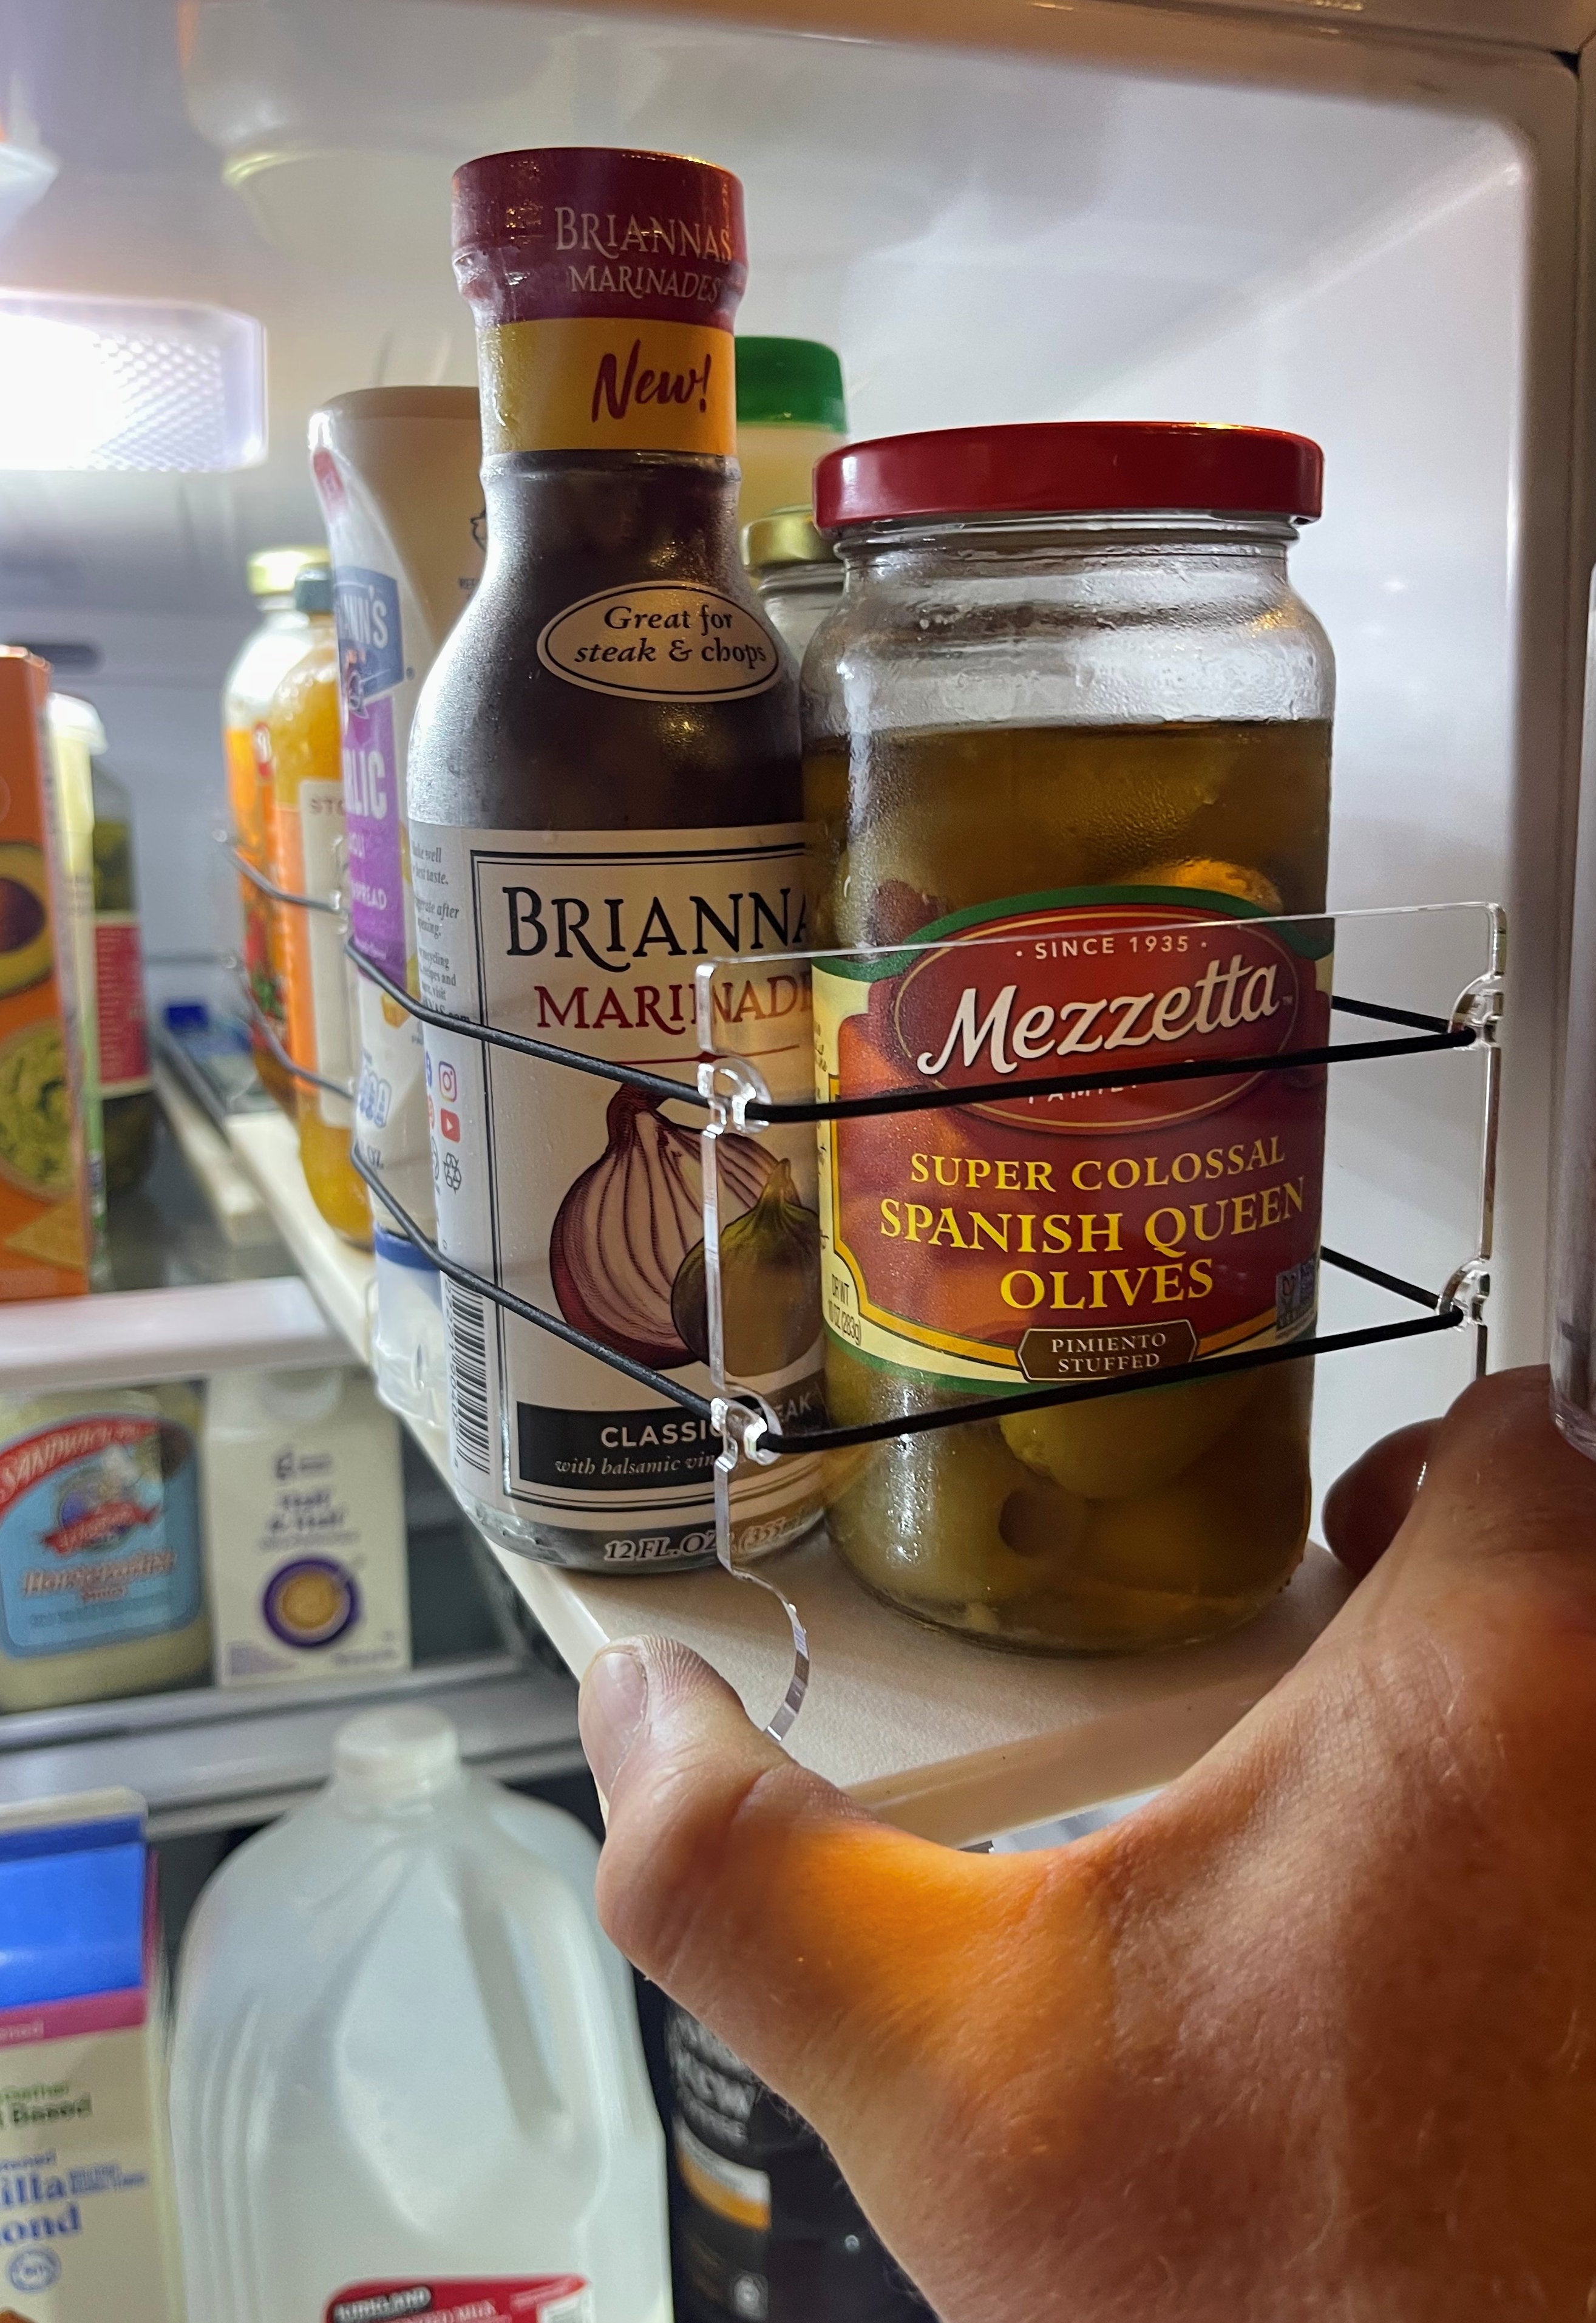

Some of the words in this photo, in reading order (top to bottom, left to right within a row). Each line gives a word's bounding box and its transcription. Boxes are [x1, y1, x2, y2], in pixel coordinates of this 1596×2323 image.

[555, 206, 732, 265] BRIANNAS
[568, 265, 722, 304] MARINADES
[591, 339, 711, 423] New!
[604, 605, 691, 630] Great
[701, 604, 732, 636] for
[574, 638, 656, 662] steak
[668, 639, 693, 662] &
[701, 638, 767, 670] chops
[437, 902, 460, 921] after
[1034, 937, 1116, 960] SINCE
[1129, 935, 1190, 954] 1935
[441, 973, 457, 987] and
[917, 953, 1279, 1075] Mezzetta
[911, 1152, 1057, 1192] SUPER
[1071, 1135, 1285, 1191] COLOSSAL
[880, 1199, 1123, 1254] SPANISH
[1145, 1177, 1306, 1258] QUEEN
[1000, 1258, 1214, 1311] OLIVES
[1050, 1333, 1166, 1353] PIMIENTO
[1058, 1353, 1160, 1373] STUFFED
[555, 1457, 595, 1475] with
[602, 1454, 681, 1475] balsamic
[606, 1540, 636, 1561] 12
